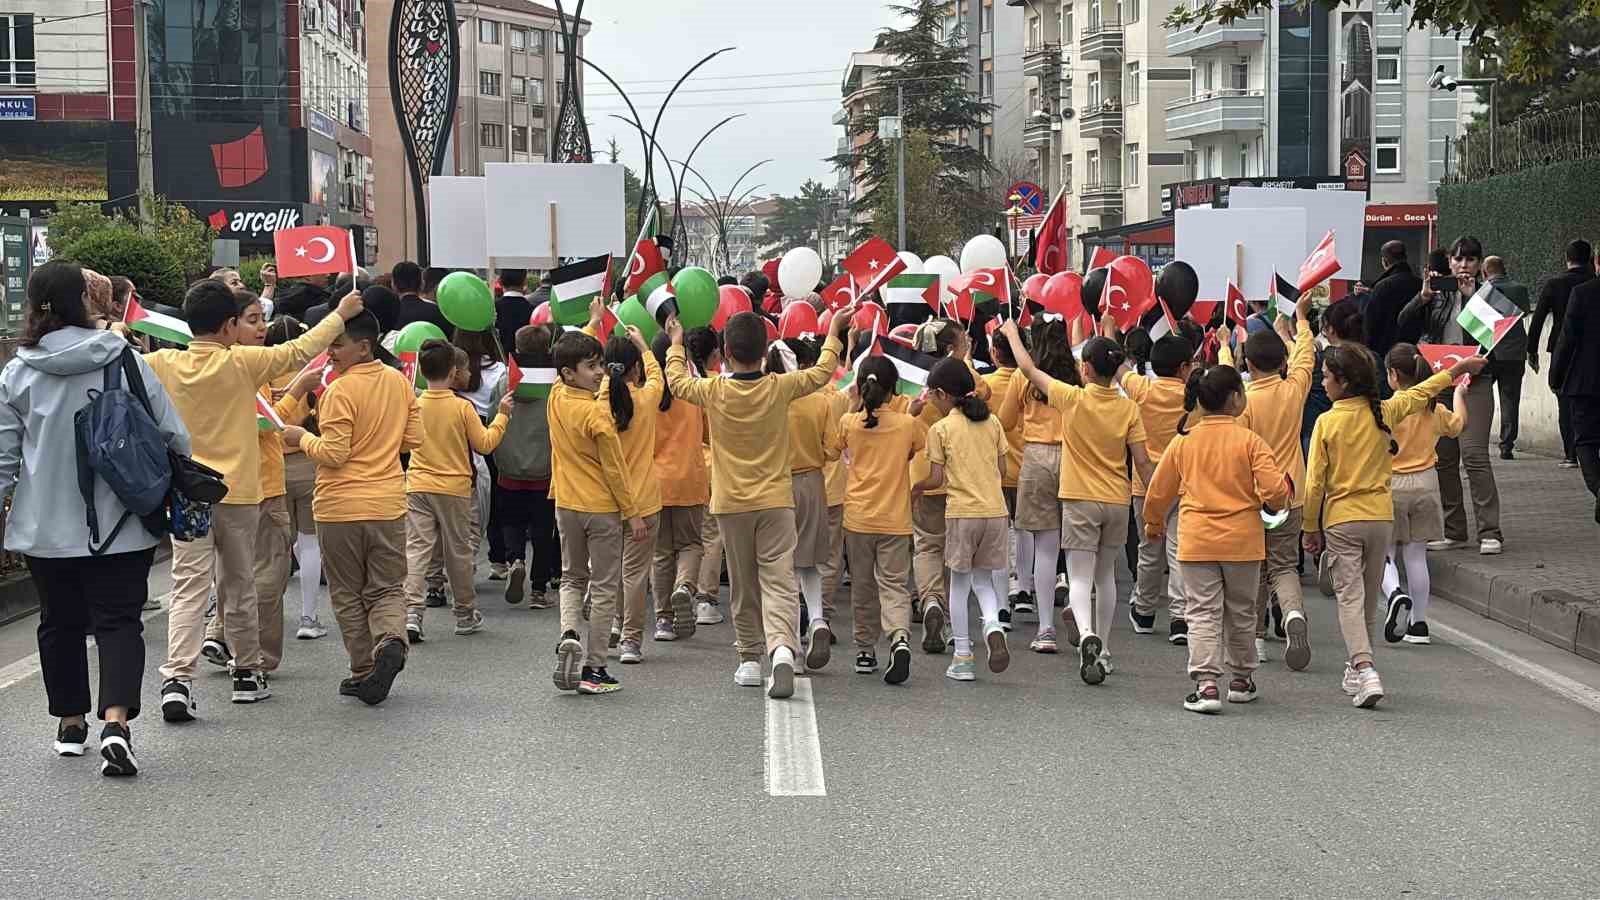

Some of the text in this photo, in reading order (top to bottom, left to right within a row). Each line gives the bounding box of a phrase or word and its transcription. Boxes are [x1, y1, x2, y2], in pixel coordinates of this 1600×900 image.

[408, 0, 425, 69] luyu
[231, 208, 299, 237] arçelik
[1366, 214, 1393, 222] Dürüm
